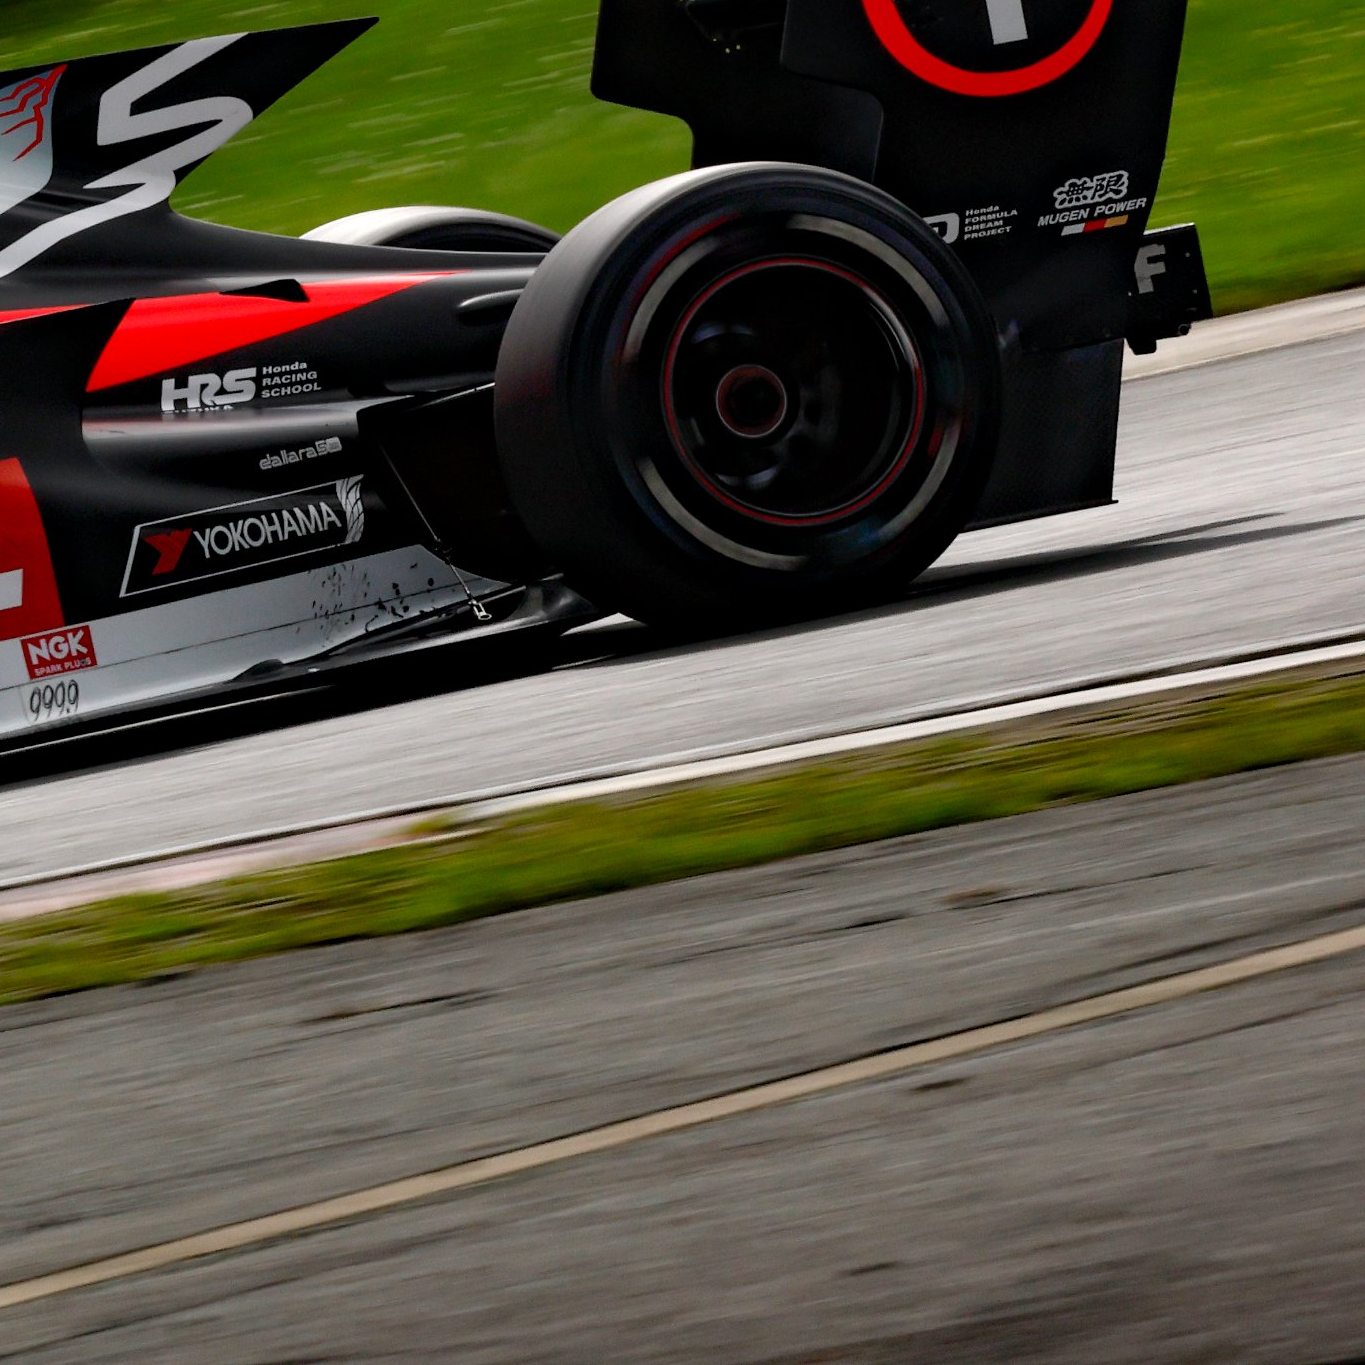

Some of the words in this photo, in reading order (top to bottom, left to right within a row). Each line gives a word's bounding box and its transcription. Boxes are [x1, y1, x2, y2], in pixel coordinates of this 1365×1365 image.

[965, 206, 1000, 216] Honda
[965, 210, 1018, 224] FORMULA
[1037, 208, 1089, 227] MUGEN
[1094, 198, 1147, 217] POWER
[964, 220, 1004, 232] DREAM
[964, 226, 1012, 240] PROJECT
[262, 361, 307, 375] Honda
[261, 371, 317, 386] RACING
[160, 367, 257, 411] HRS
[261, 383, 322, 398] SCHOOL
[193, 501, 342, 559] YOKOHAMA
[27, 630, 88, 665] NGK
[34, 663, 62, 677] SPARK
